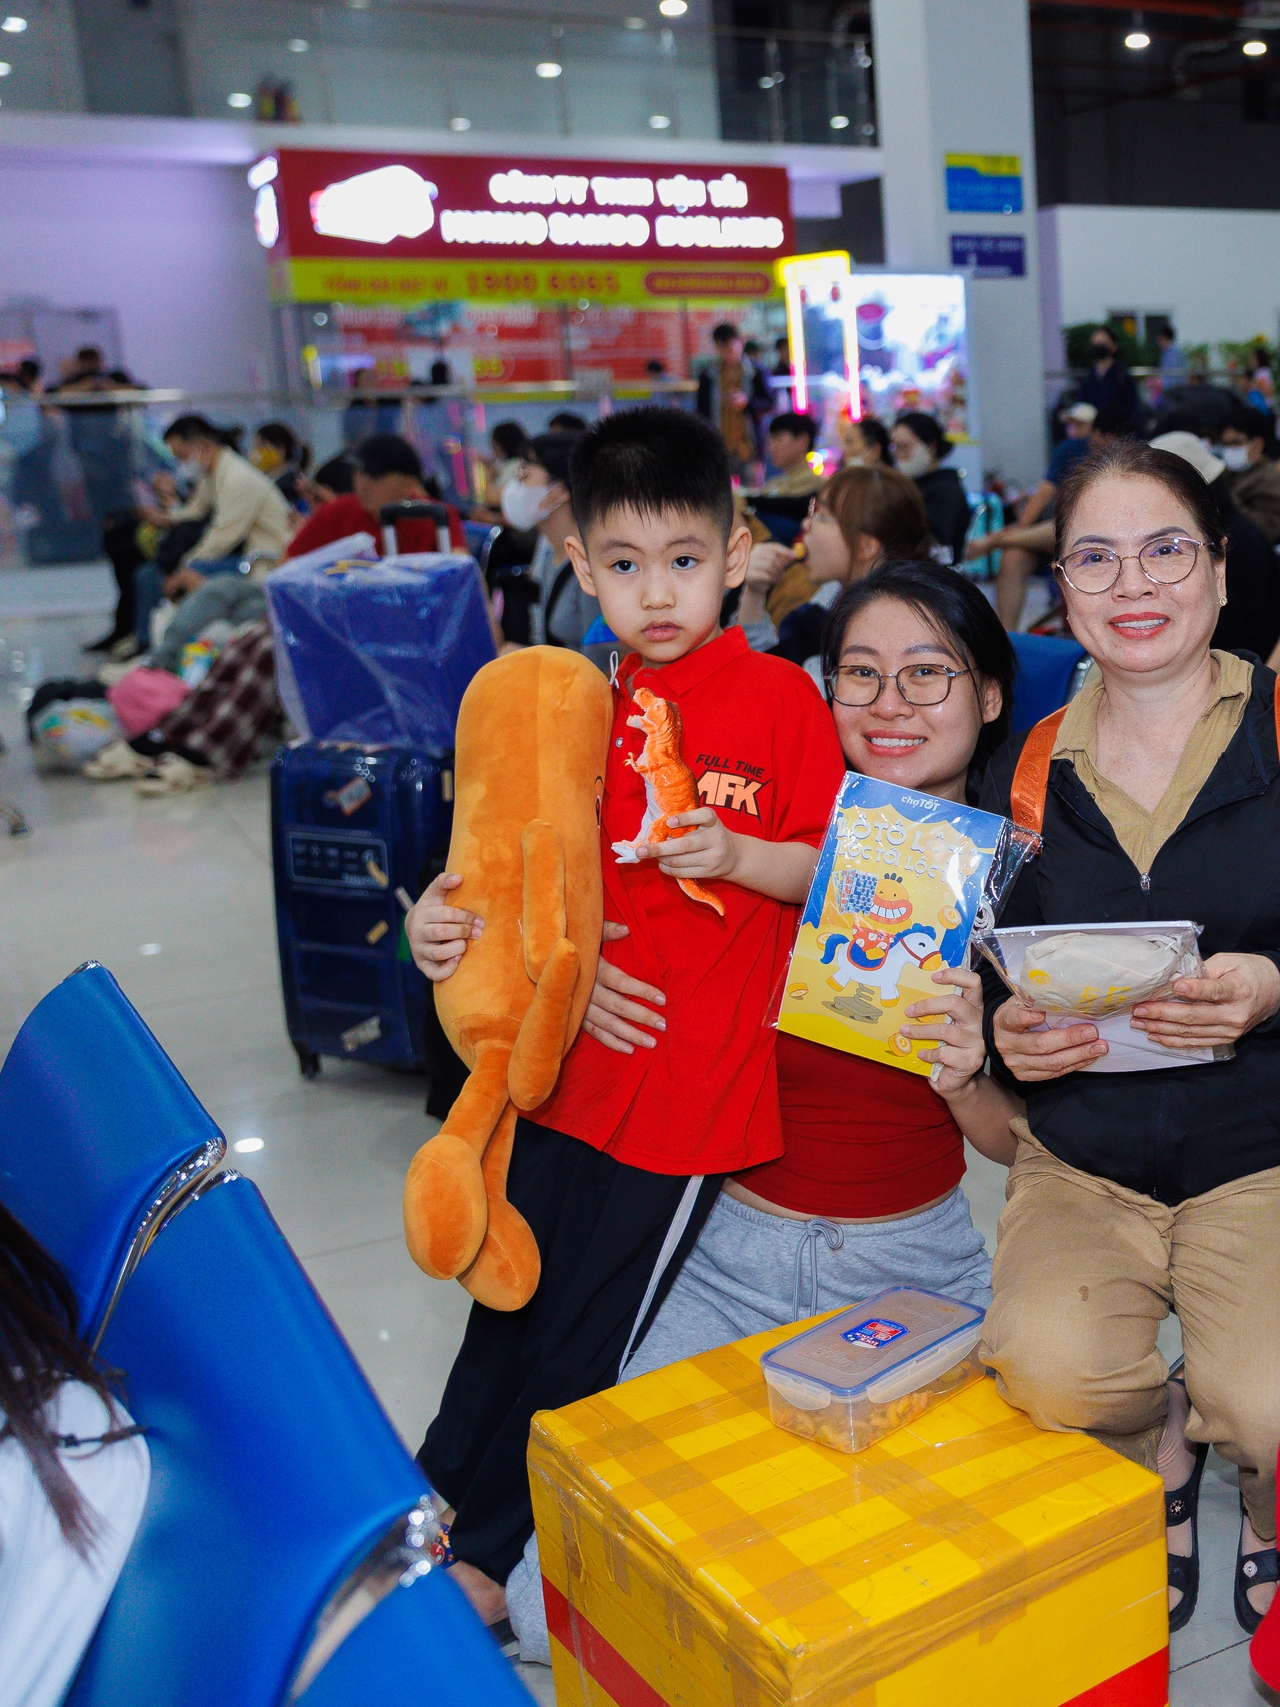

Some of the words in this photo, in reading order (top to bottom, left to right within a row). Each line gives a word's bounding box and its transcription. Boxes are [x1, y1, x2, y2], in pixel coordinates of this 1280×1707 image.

[695, 753, 730, 769] FULL
[735, 760, 765, 778] TIME
[696, 769, 763, 817] AFK
[904, 855, 939, 878] LỘC
